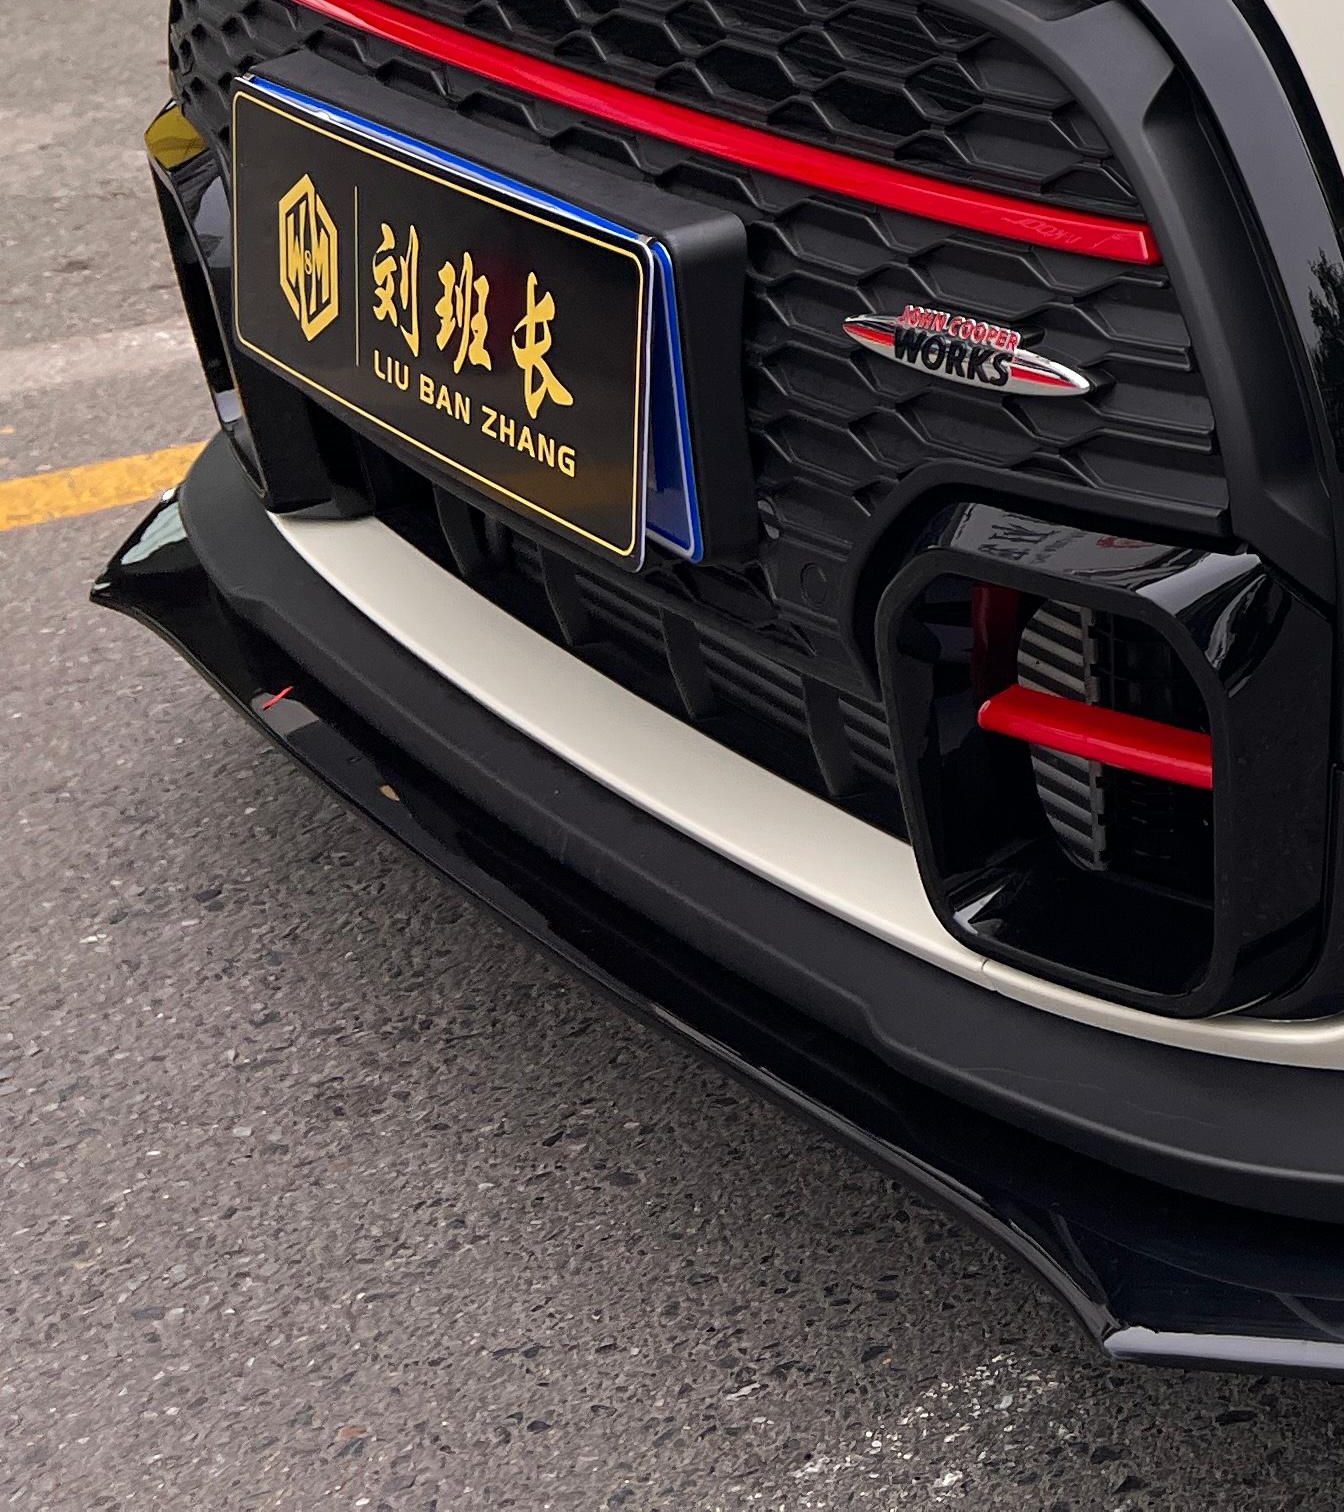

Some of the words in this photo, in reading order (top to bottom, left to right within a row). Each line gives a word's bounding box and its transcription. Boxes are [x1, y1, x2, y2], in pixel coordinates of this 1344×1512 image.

[371, 223, 574, 419] 刘班长
[894, 328, 1013, 386] WORKS
[948, 316, 1021, 351] COOPER
[374, 349, 409, 391] LIU
[419, 373, 472, 425] BAN
[481, 405, 577, 478] ZHANG
